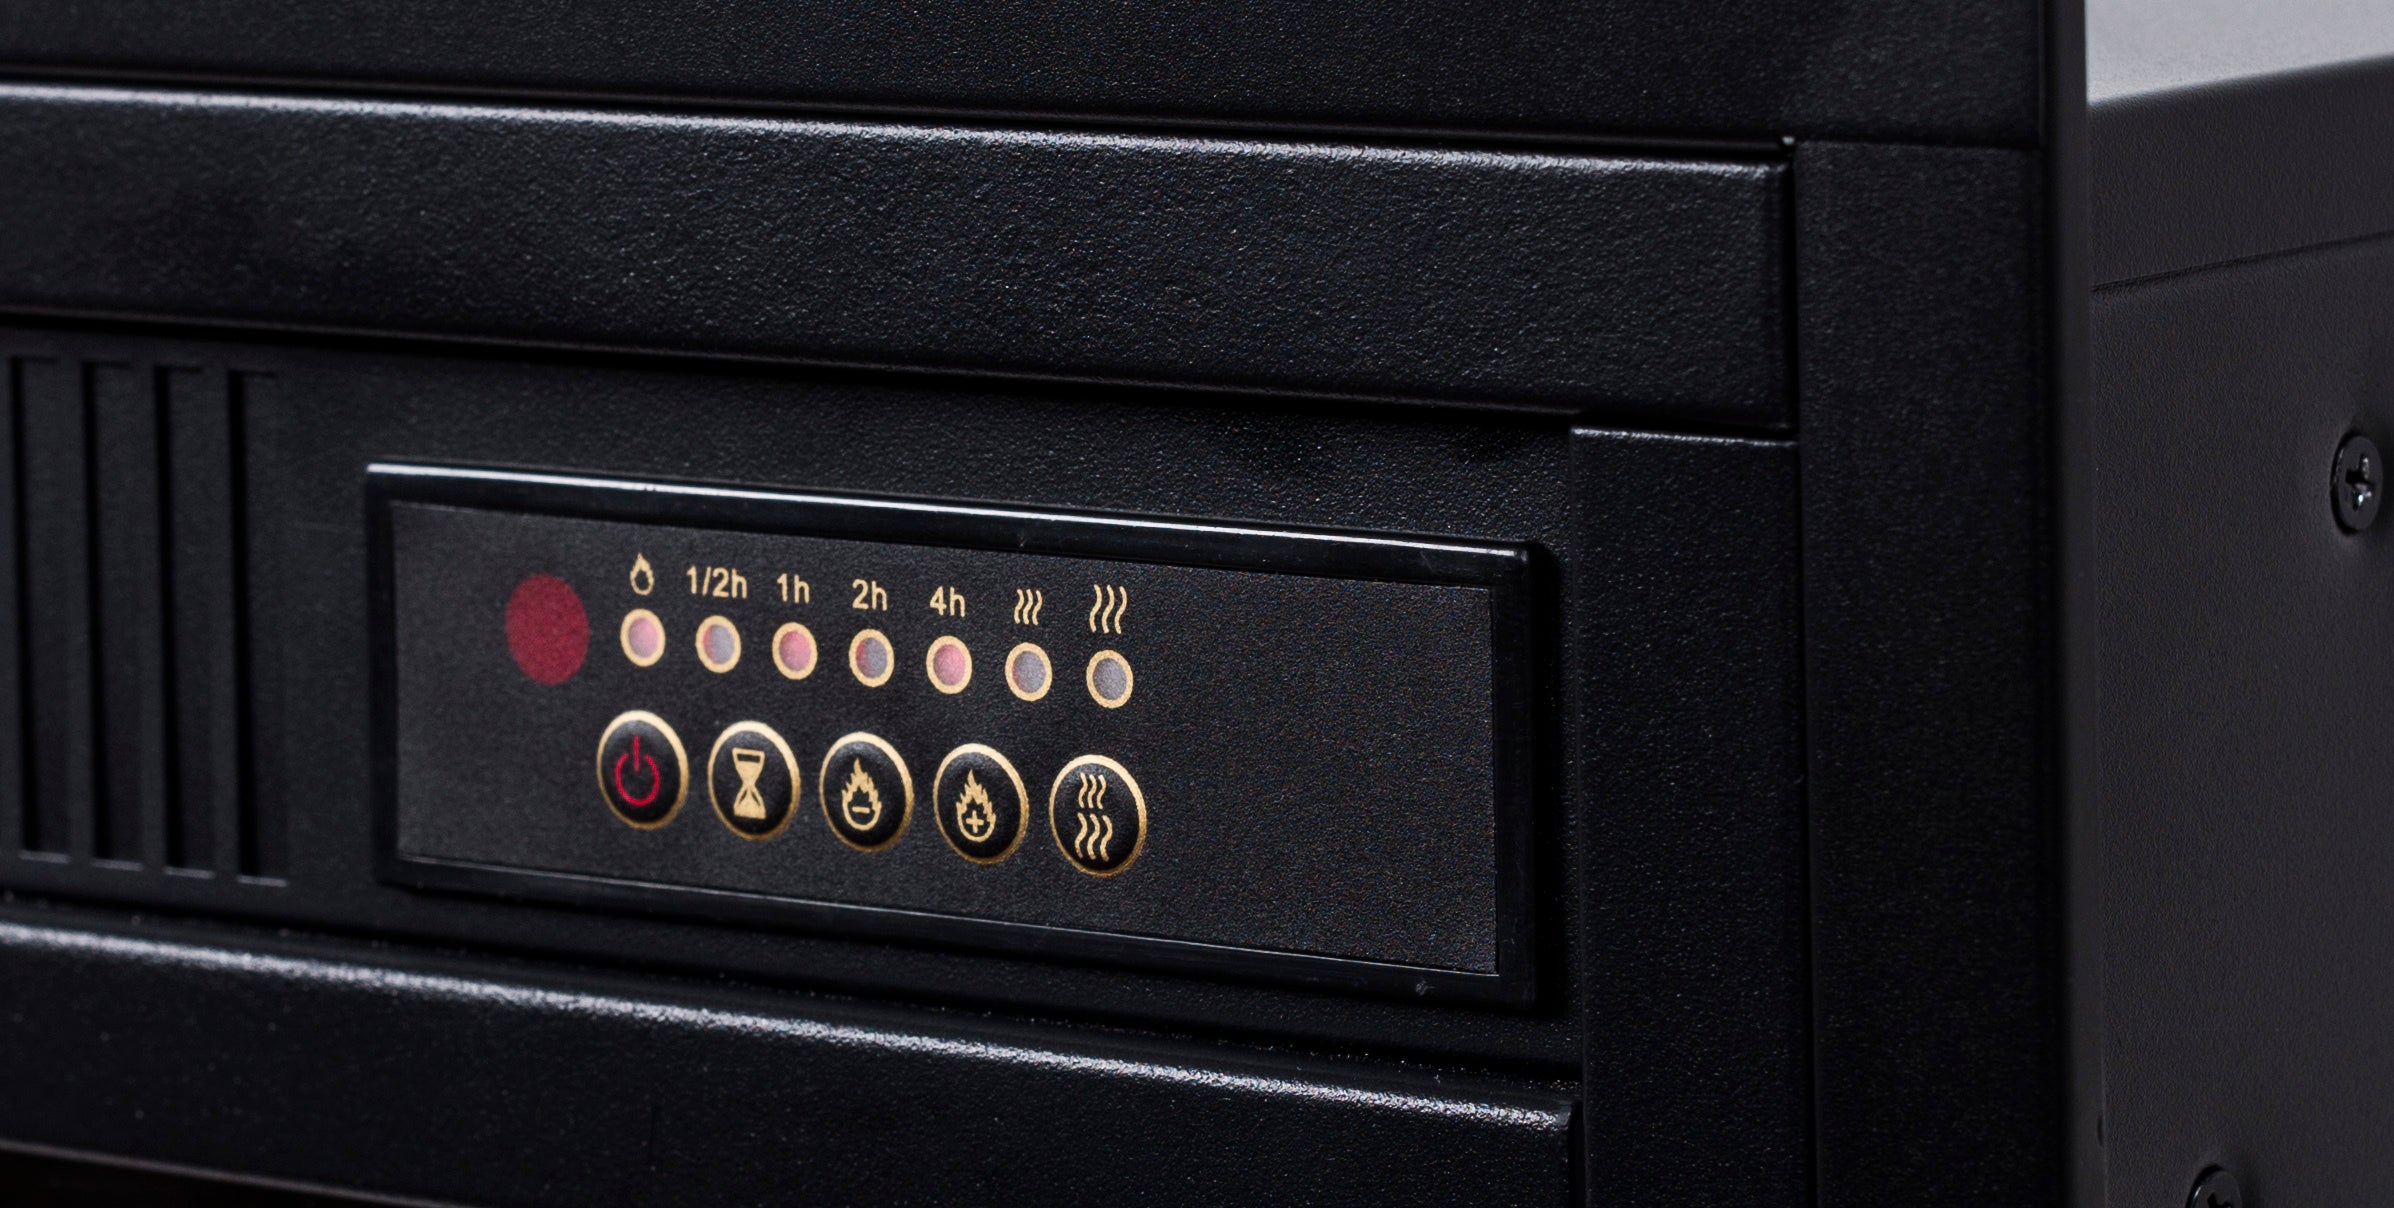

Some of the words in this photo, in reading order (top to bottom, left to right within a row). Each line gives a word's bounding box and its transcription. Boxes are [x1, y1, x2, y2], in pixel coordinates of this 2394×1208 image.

[686, 565, 748, 597] 1/2h
[777, 573, 811, 604] 1h
[852, 579, 888, 611] 2h
[930, 586, 967, 617] 4h
